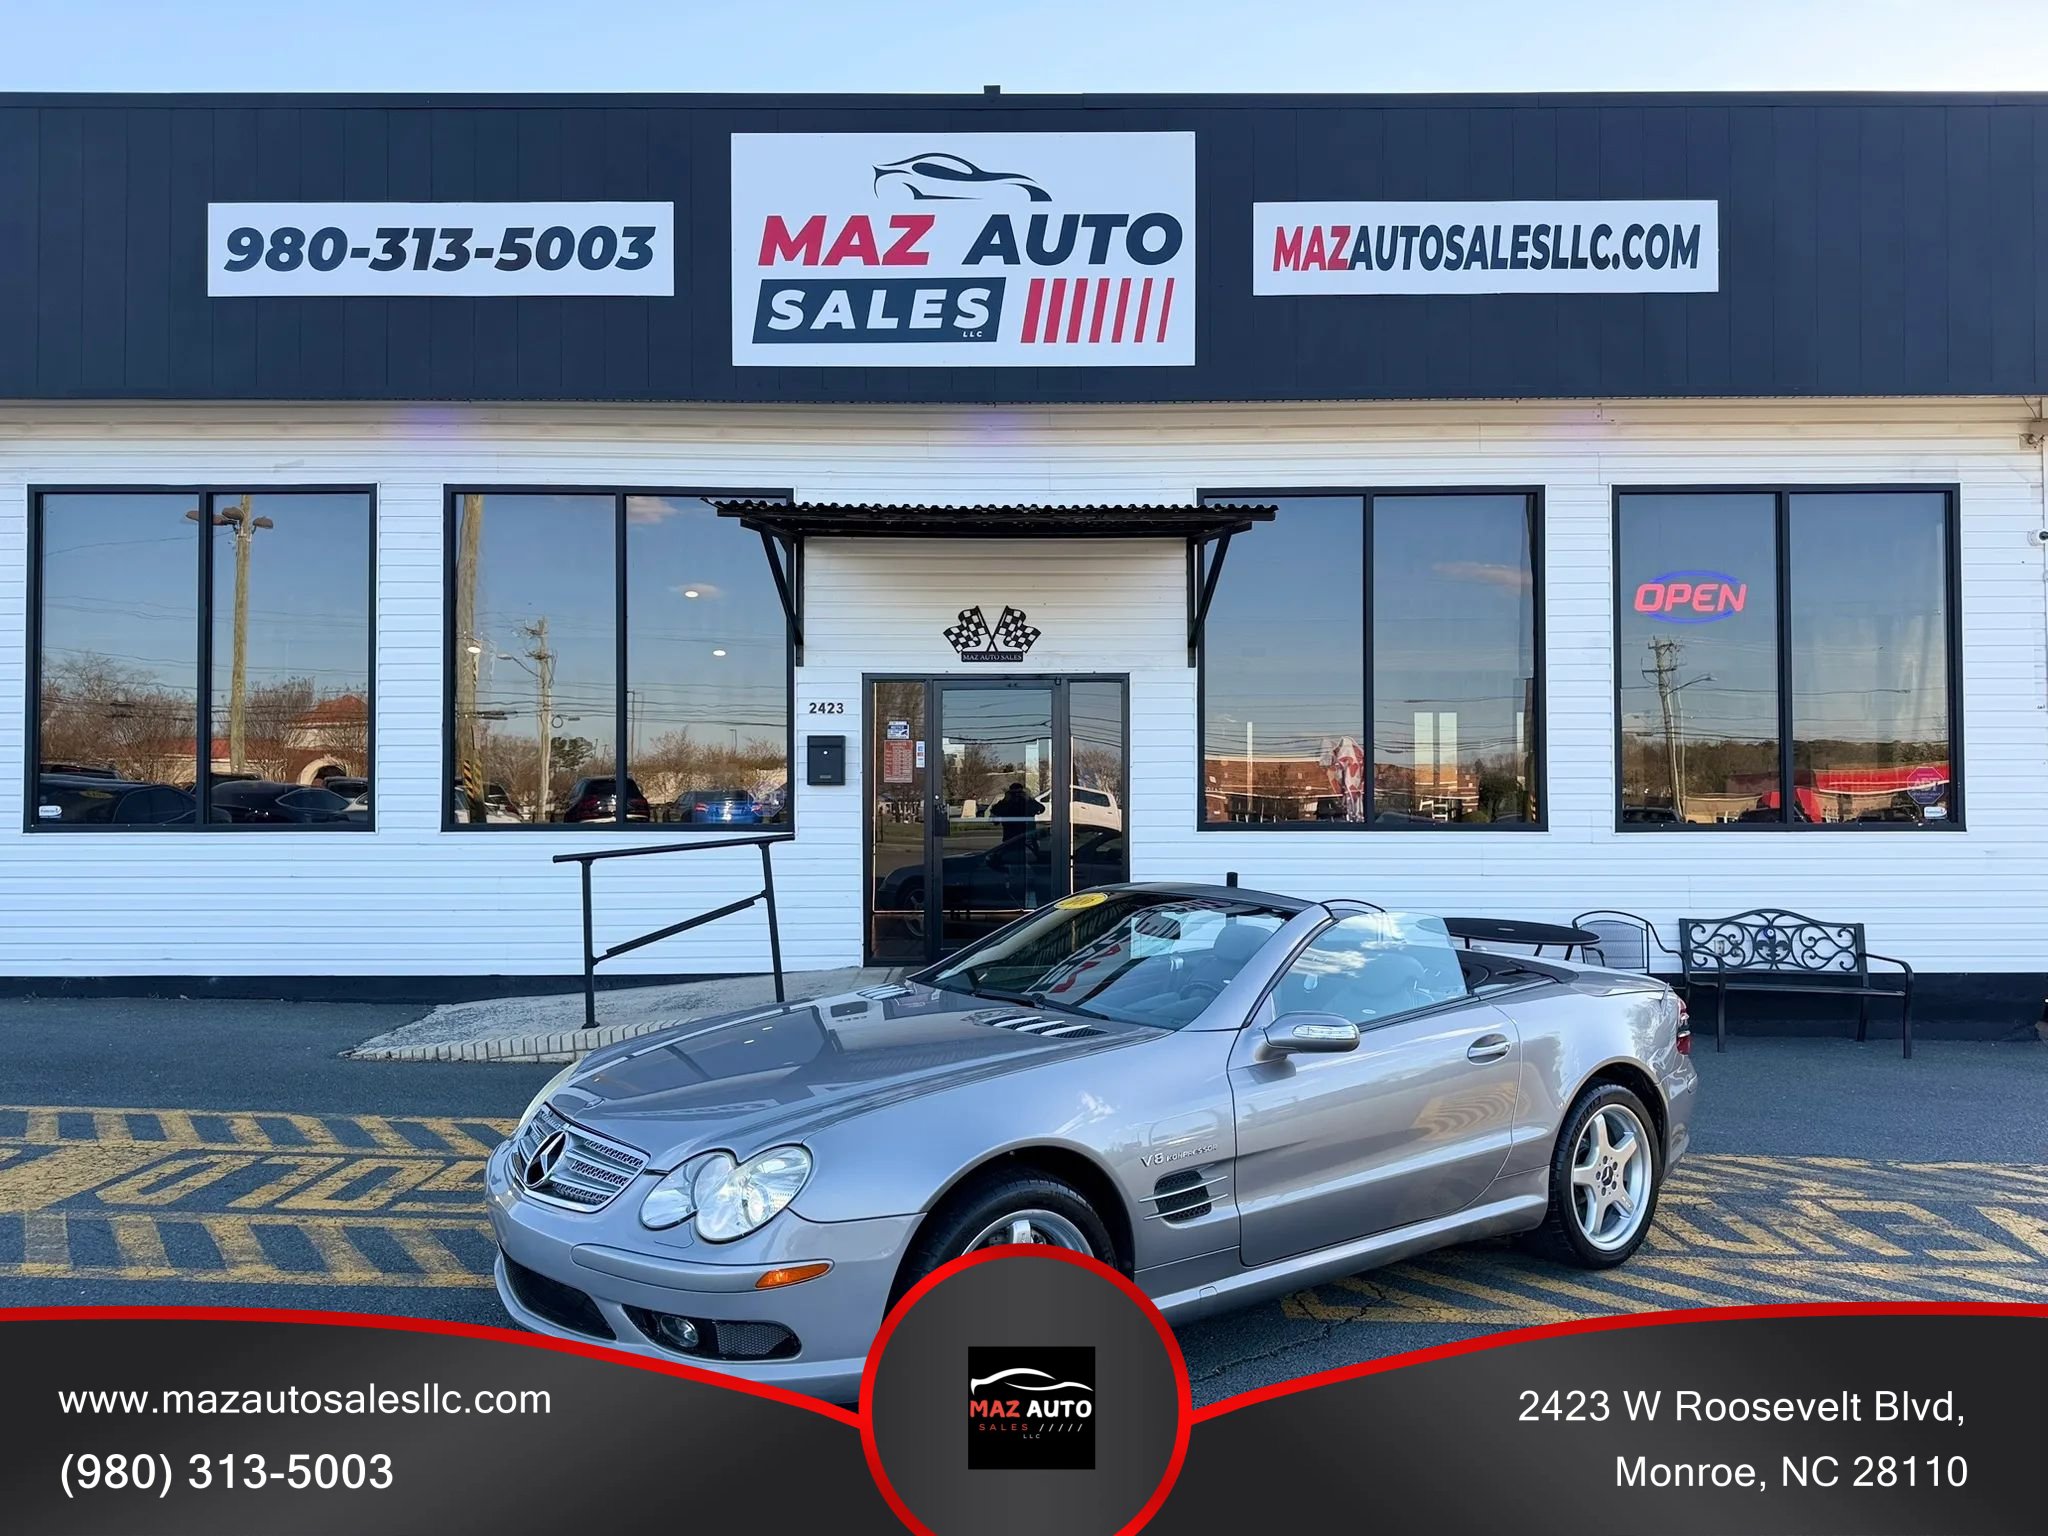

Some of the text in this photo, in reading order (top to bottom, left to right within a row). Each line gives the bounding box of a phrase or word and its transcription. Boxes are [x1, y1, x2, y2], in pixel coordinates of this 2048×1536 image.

[223, 226, 656, 272] 980-313-5003
[758, 212, 1184, 266] MAZ AUTO
[1272, 223, 1701, 272] MAZAUTOSALESLLC.COM
[766, 288, 992, 331] SALES
[962, 330, 983, 338] LLC
[1633, 582, 1747, 613] OPEN
[963, 653, 1022, 661] MAZ AUTO SALES
[808, 702, 844, 715] 2423
[1140, 1151, 1164, 1168] V8
